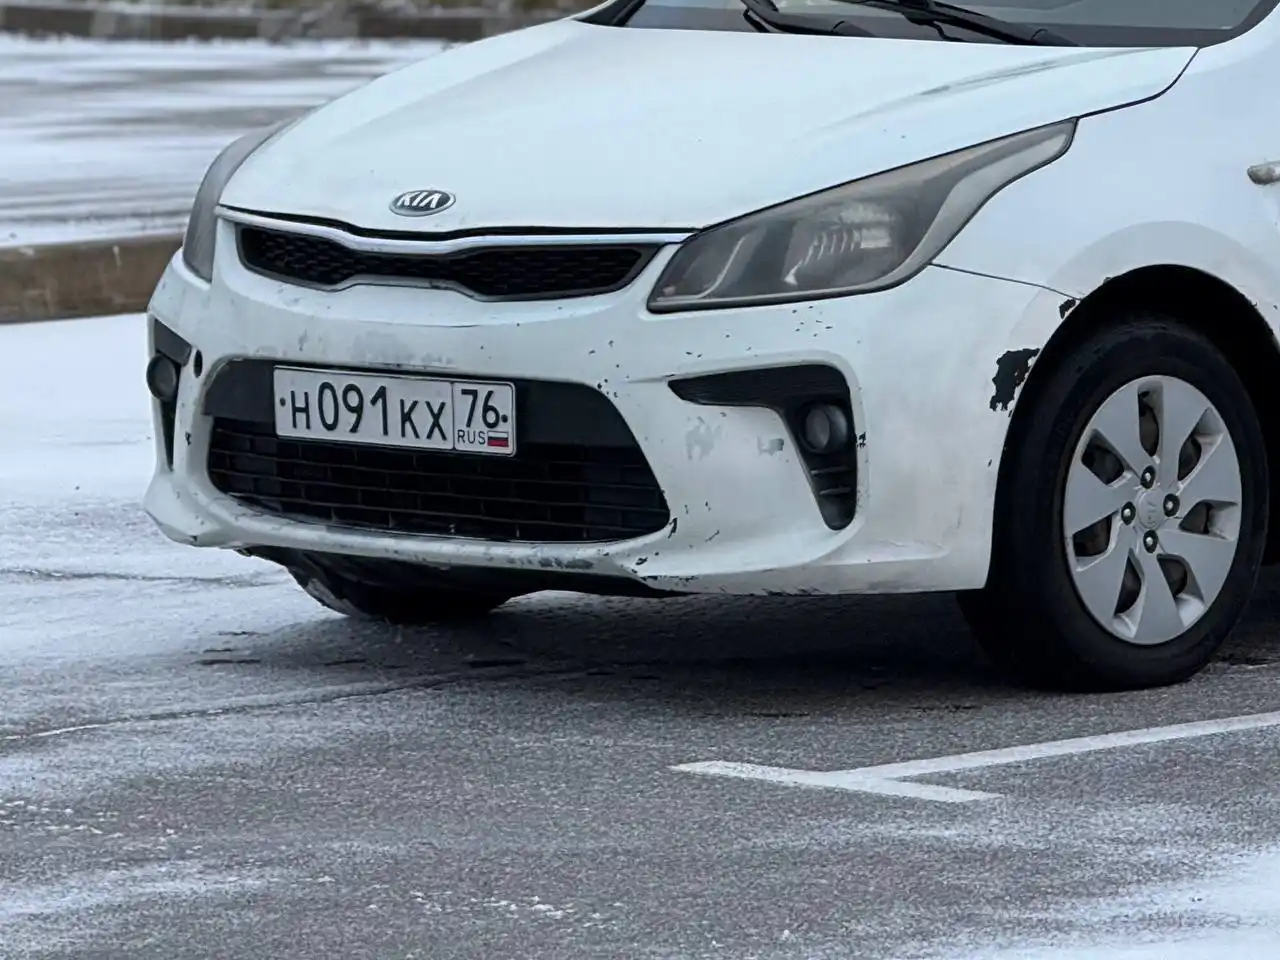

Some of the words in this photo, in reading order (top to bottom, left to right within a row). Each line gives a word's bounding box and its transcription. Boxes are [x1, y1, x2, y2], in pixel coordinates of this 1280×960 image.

[396, 191, 442, 209] KIA
[460, 388, 500, 429] 76
[456, 429, 487, 445] RUS
